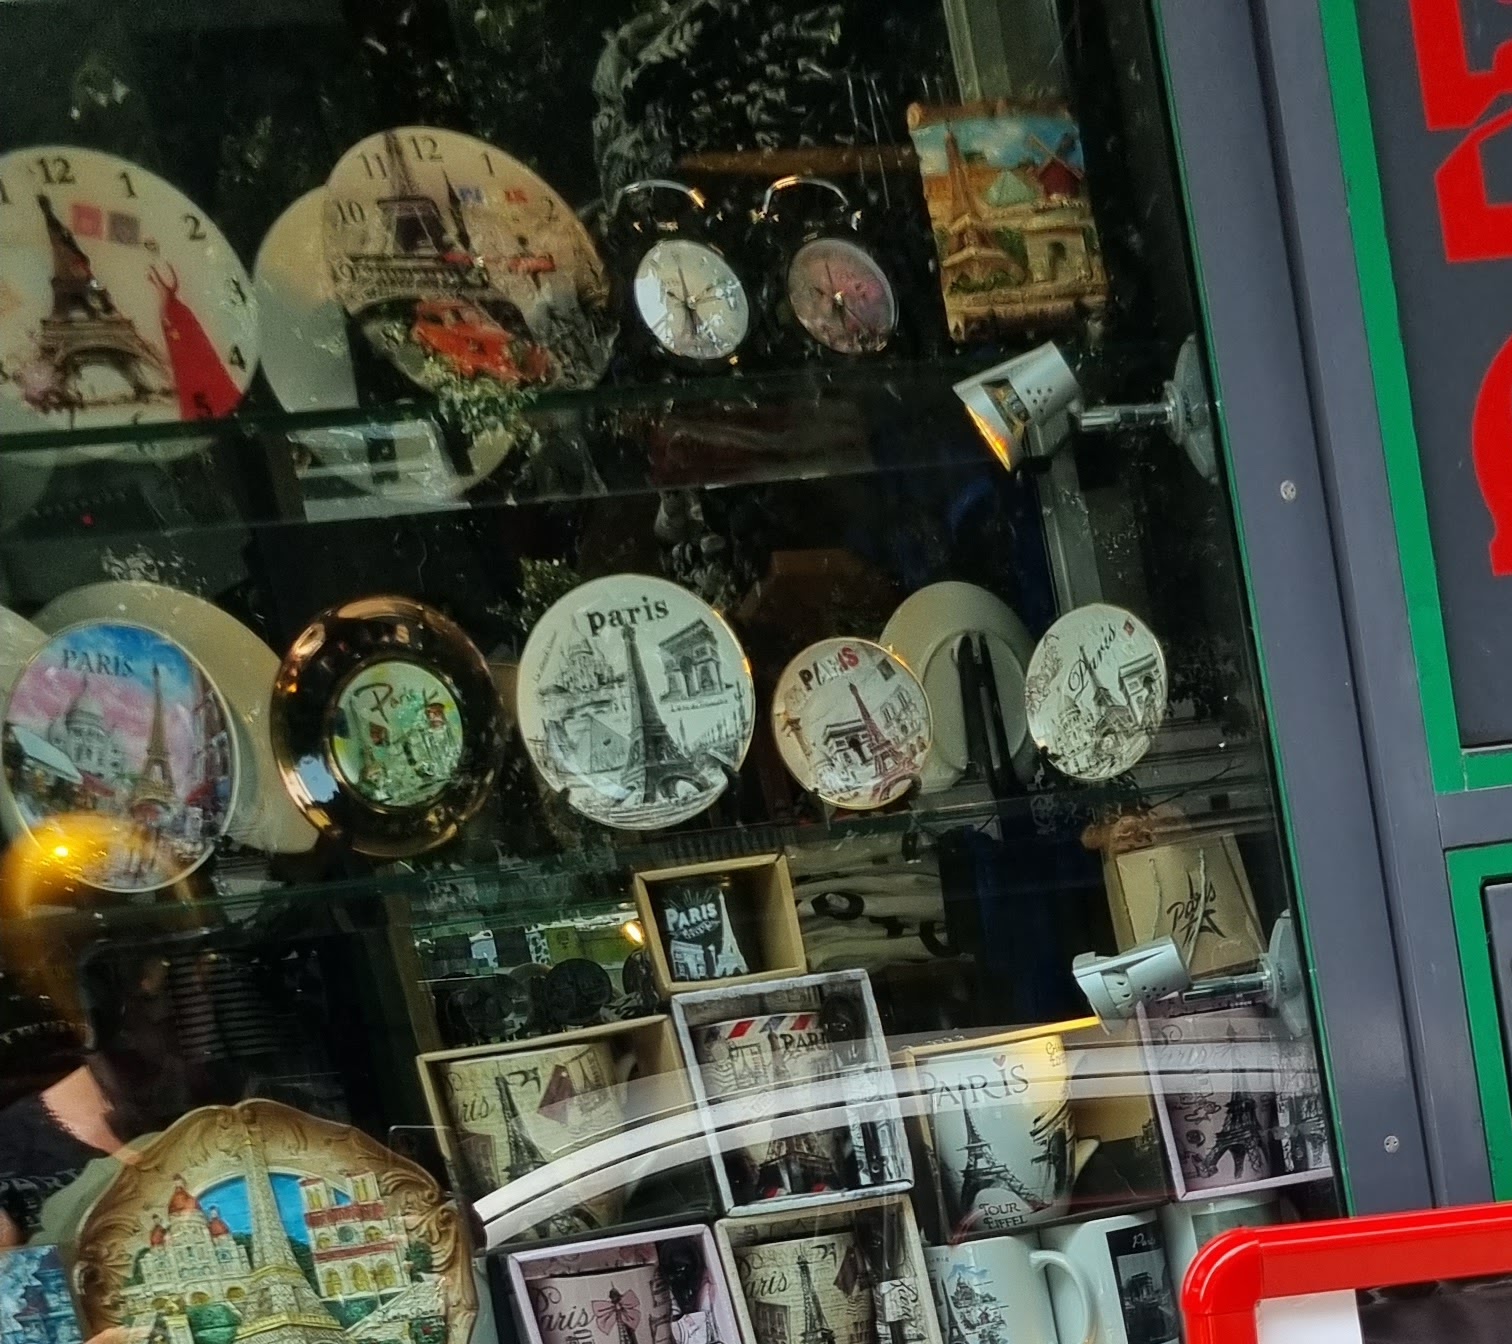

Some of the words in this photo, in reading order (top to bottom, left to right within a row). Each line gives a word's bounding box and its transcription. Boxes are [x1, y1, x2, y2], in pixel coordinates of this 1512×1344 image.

[410, 136, 445, 162] 12
[38, 156, 75, 185] 12
[480, 151, 496, 177] 1
[119, 171, 137, 199] 1
[184, 212, 207, 241] 2
[230, 345, 246, 373] 4
[586, 597, 669, 637] paris
[62, 648, 135, 677] PARIS
[1067, 622, 1117, 701] Paris
[665, 900, 719, 932] PARIS
[779, 1030, 830, 1052] PARI
[978, 1201, 1021, 1217] TOUR
[983, 1215, 1028, 1231] EIFFEL
[530, 1285, 593, 1333] Paris
